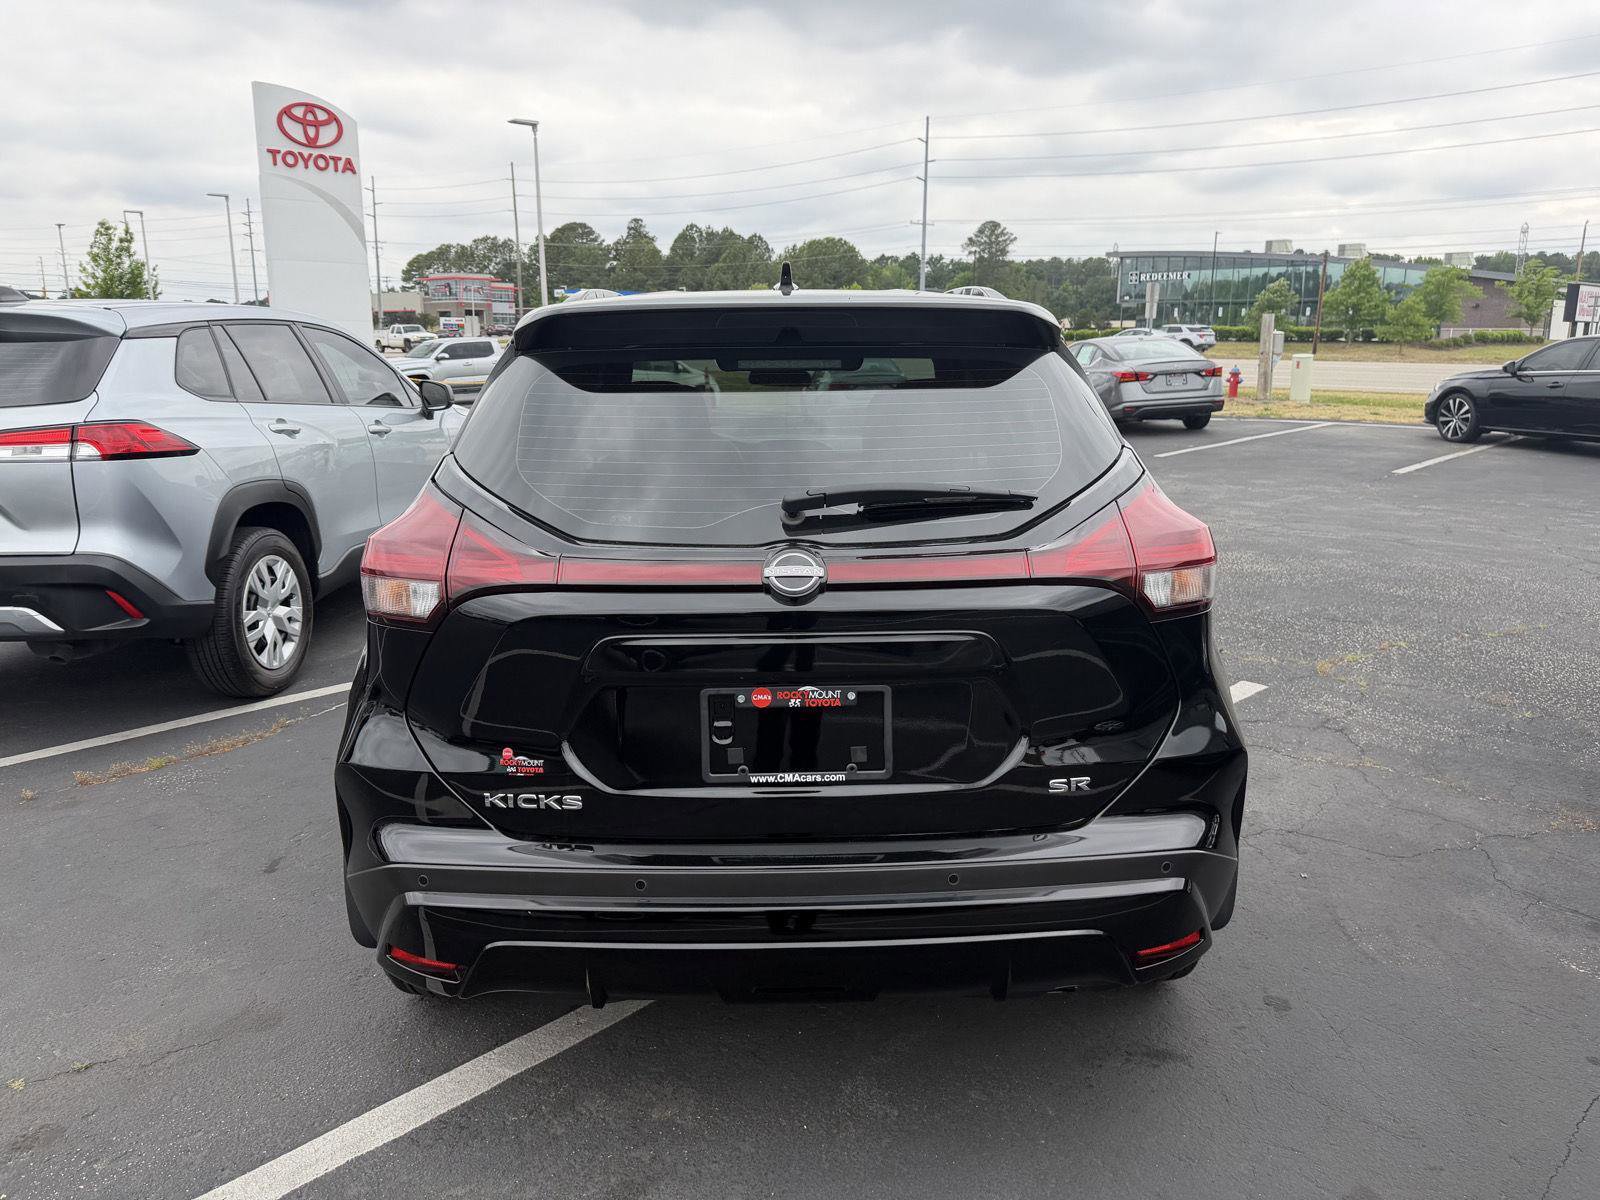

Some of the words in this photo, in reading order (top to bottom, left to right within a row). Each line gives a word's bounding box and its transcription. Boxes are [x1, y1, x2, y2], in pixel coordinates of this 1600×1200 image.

[266, 148, 356, 175] TOYOTA
[1140, 271, 1190, 281] REDEEMER
[765, 567, 824, 577] NISSAN
[805, 698, 842, 707] TOYOTA
[750, 773, 846, 783] www.CMAcars.com
[1048, 776, 1091, 793] SR
[483, 792, 583, 810] KICKS
